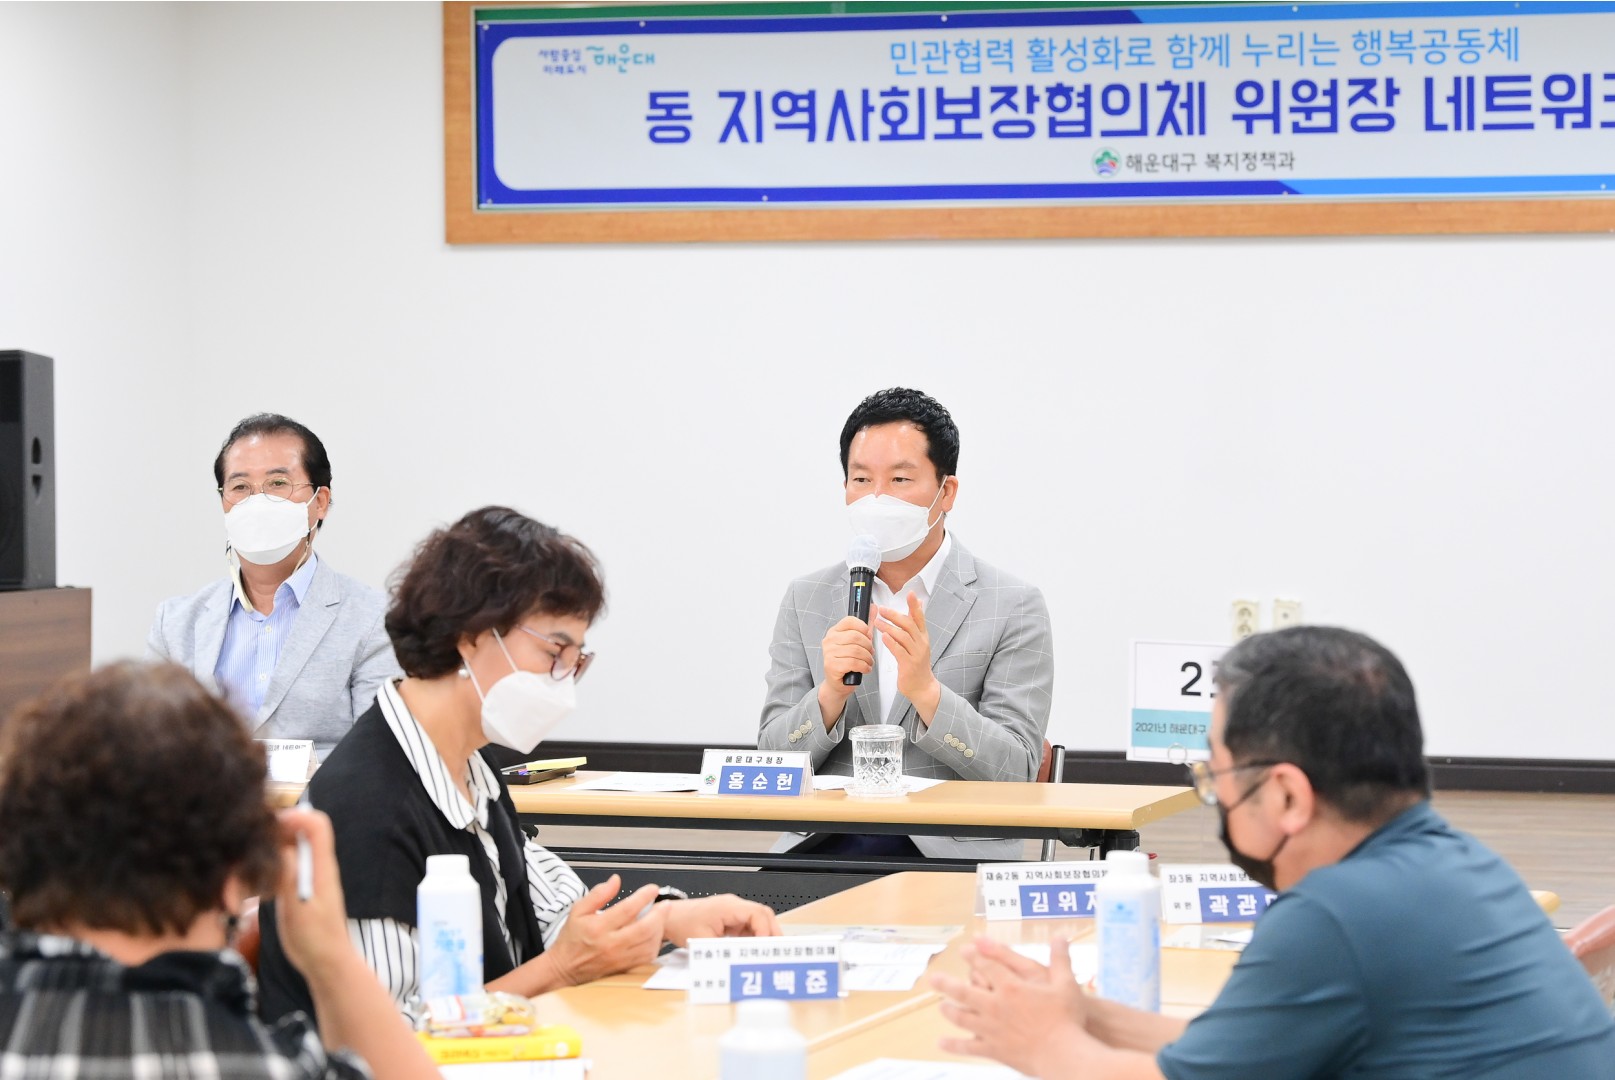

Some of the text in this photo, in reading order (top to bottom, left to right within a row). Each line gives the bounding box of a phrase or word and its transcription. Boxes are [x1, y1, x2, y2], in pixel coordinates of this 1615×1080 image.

[585, 43, 656, 74] 해운대
[890, 27, 1520, 75] 민관협력 활성화로 함께 누리는 행복공동체
[645, 91, 693, 144] 동
[717, 80, 1207, 144] 지역사회보장협의체
[1232, 77, 1401, 134] 위원장
[1125, 150, 1296, 173] 해운대구 복지정책과
[1181, 661, 1218, 698] 2
[1135, 722, 1167, 734] 2021년
[725, 755, 783, 765] 해운대구청장
[728, 772, 793, 791] 홍순헌
[986, 872, 1019, 881] 재송2동
